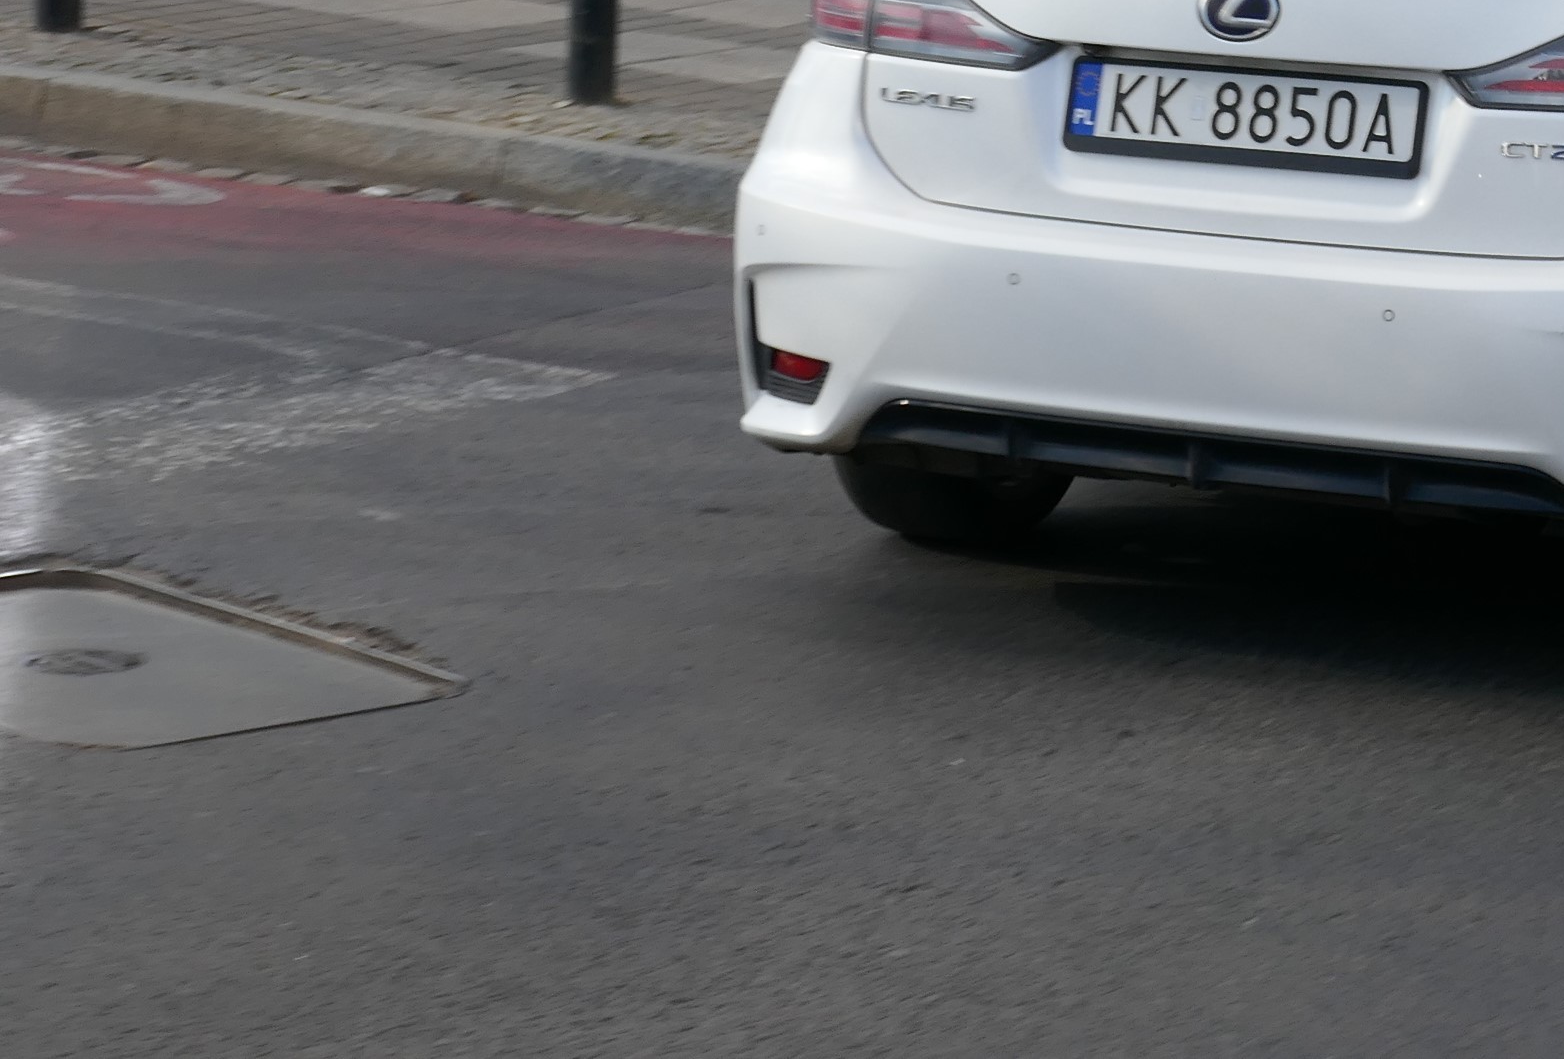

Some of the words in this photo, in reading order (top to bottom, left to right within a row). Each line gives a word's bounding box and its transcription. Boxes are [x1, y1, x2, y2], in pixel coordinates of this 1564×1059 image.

[880, 87, 976, 112] LEXUS
[1072, 107, 1094, 125] PL
[1110, 73, 1187, 137] KK
[1211, 81, 1394, 155] 8850A
